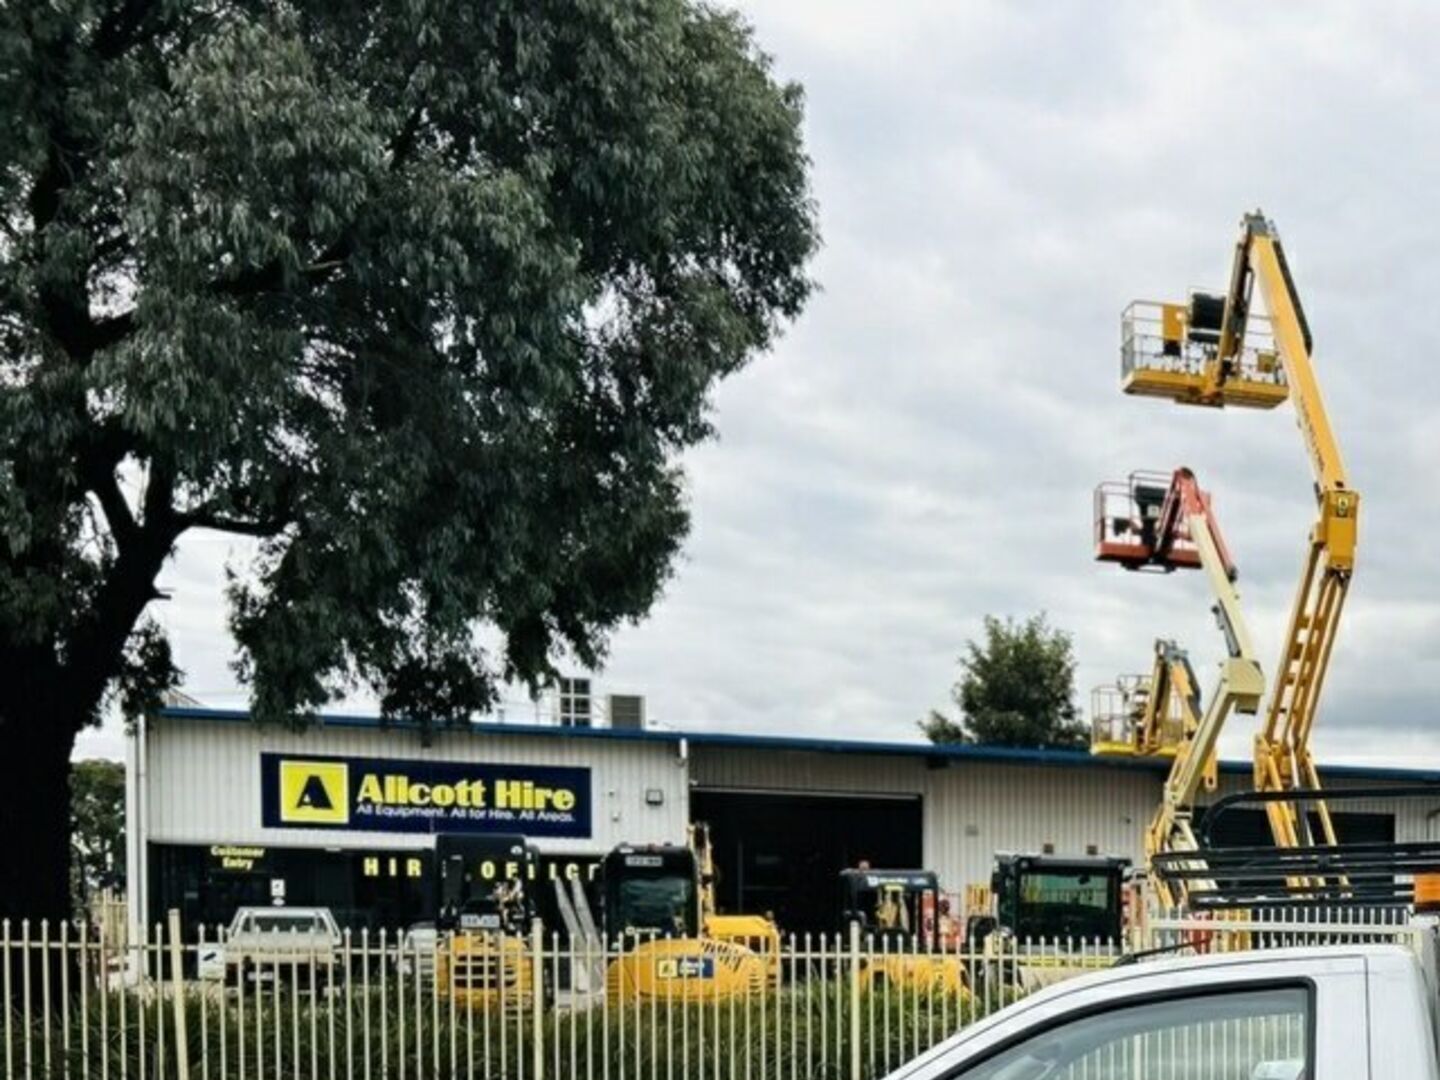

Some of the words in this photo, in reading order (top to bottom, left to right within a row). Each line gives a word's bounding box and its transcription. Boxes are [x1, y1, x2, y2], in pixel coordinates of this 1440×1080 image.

[357, 773, 486, 807] Allcott
[495, 780, 576, 811] Hire
[356, 804, 373, 816] All
[450, 807, 467, 818] All
[469, 808, 486, 819] for
[519, 810, 535, 821] All
[363, 857, 422, 877] HIR
